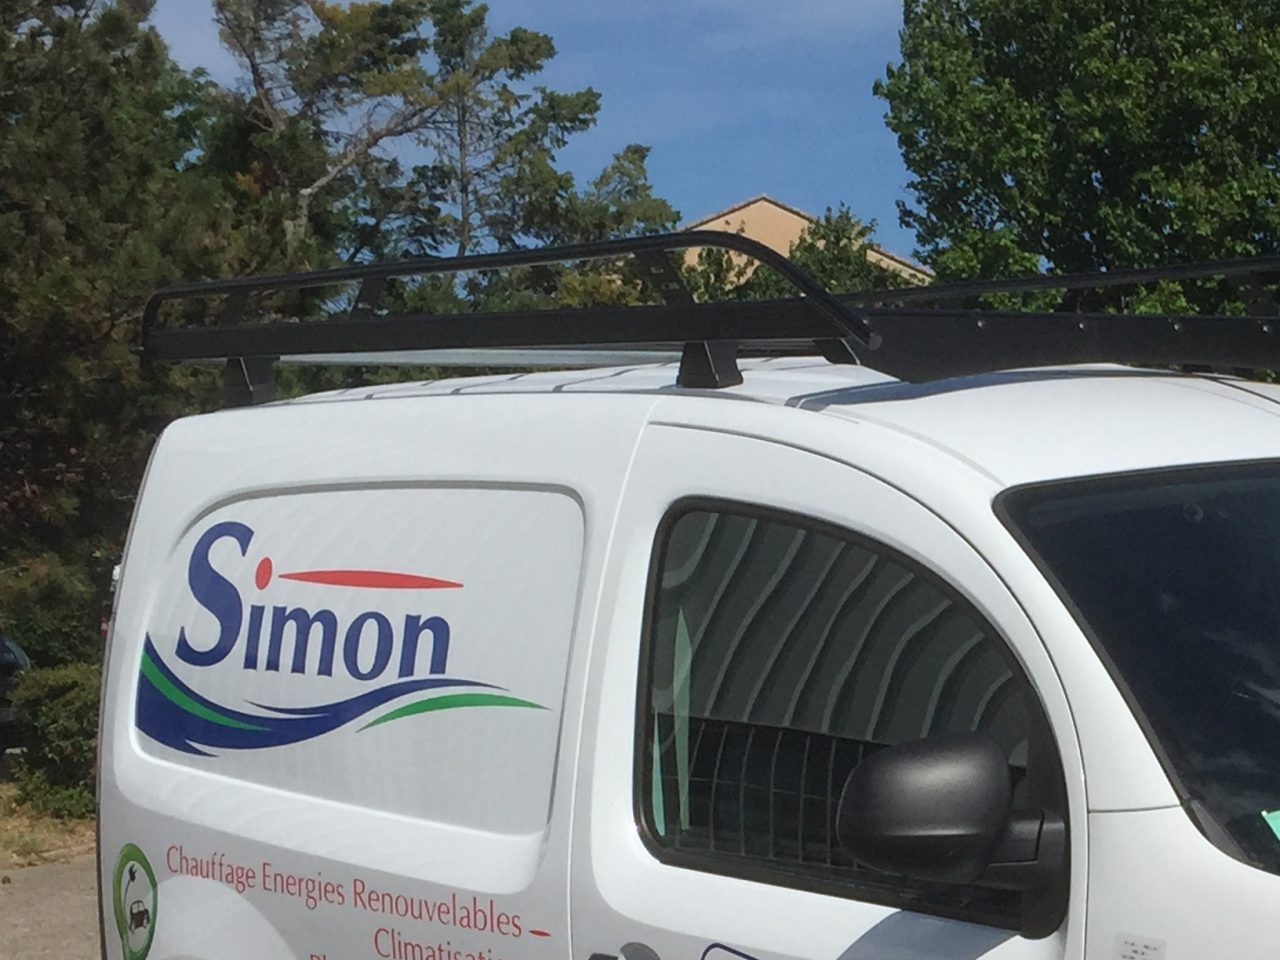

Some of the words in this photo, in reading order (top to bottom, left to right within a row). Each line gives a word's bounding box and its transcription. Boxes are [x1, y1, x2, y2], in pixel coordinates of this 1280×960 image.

[174, 521, 451, 681] Simon
[166, 845, 256, 894] Chauffage
[262, 862, 345, 910] Energies
[353, 878, 522, 938] Renouvelables
